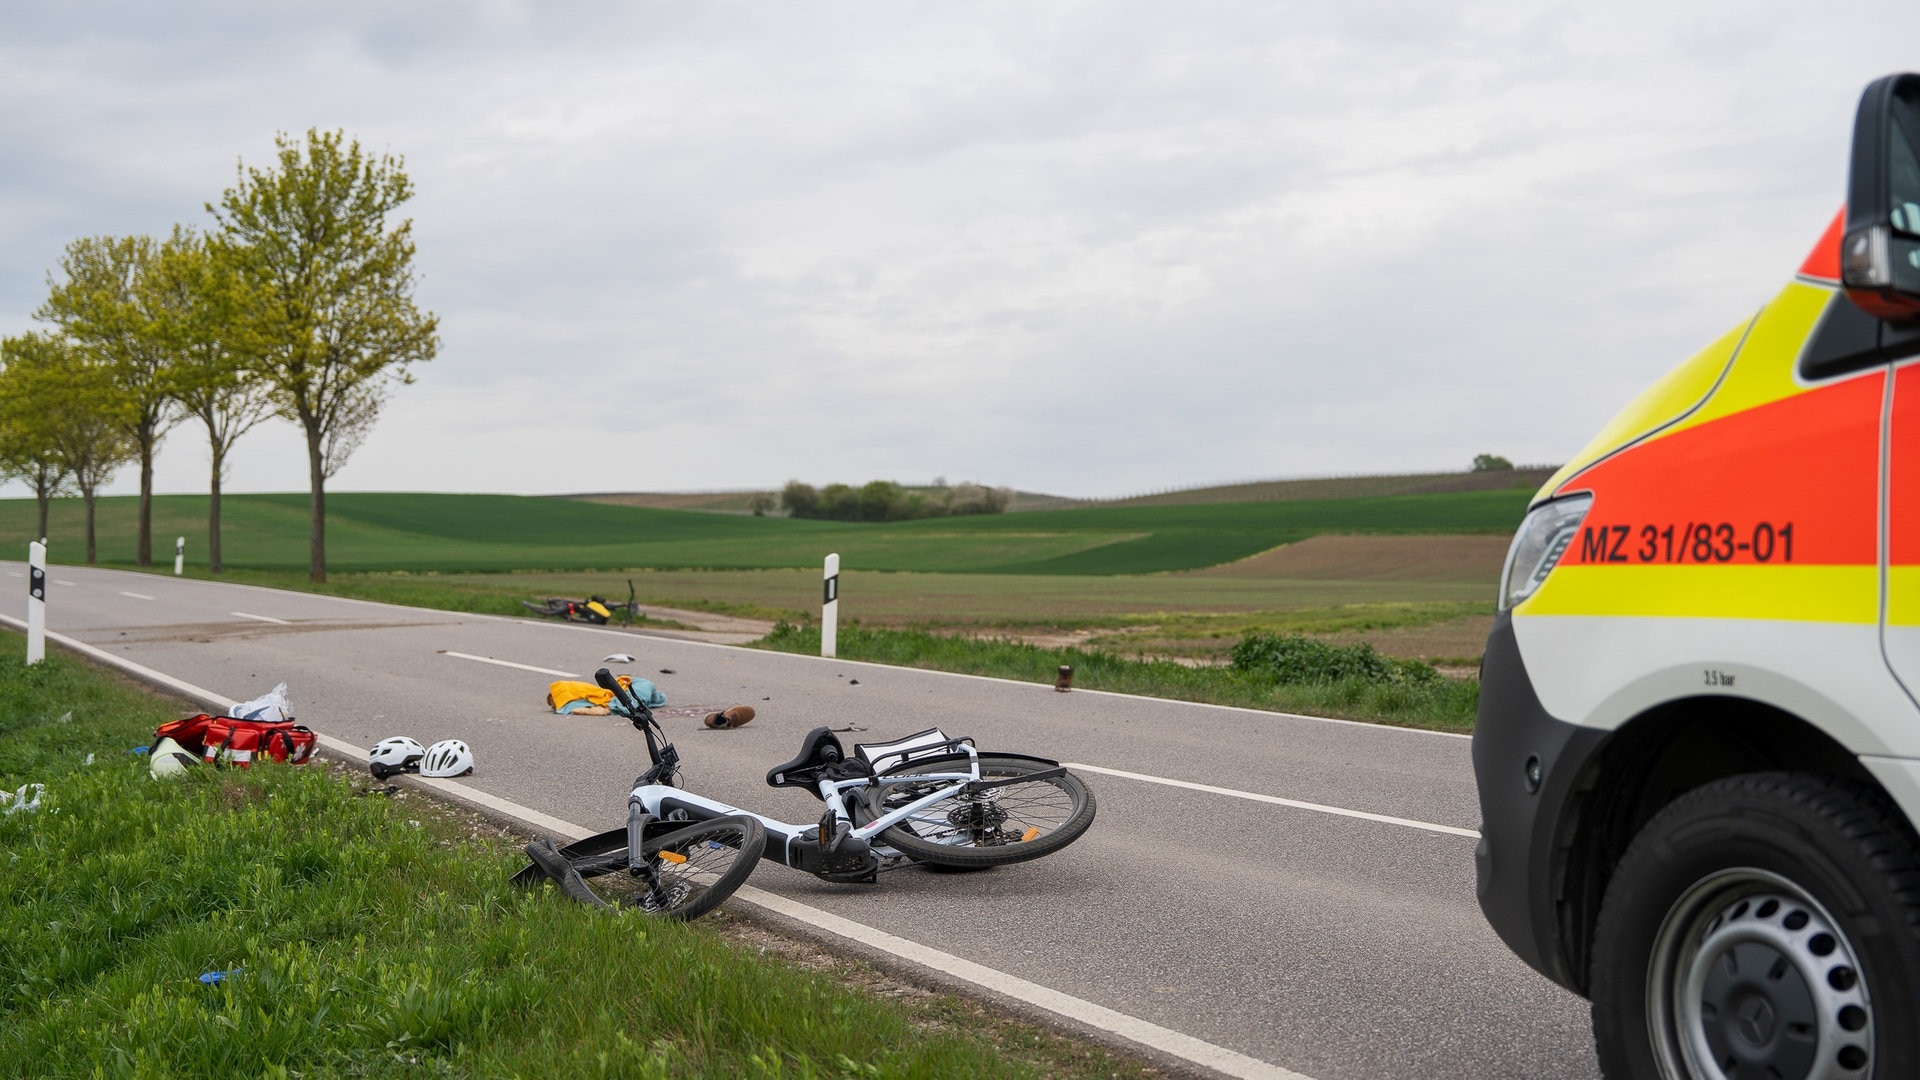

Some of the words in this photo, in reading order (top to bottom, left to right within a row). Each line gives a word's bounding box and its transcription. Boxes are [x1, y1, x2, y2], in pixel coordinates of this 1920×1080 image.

[1581, 525, 1630, 562] MZ
[1638, 522, 1793, 563] 31/83-01
[1719, 670, 1735, 687] bar
